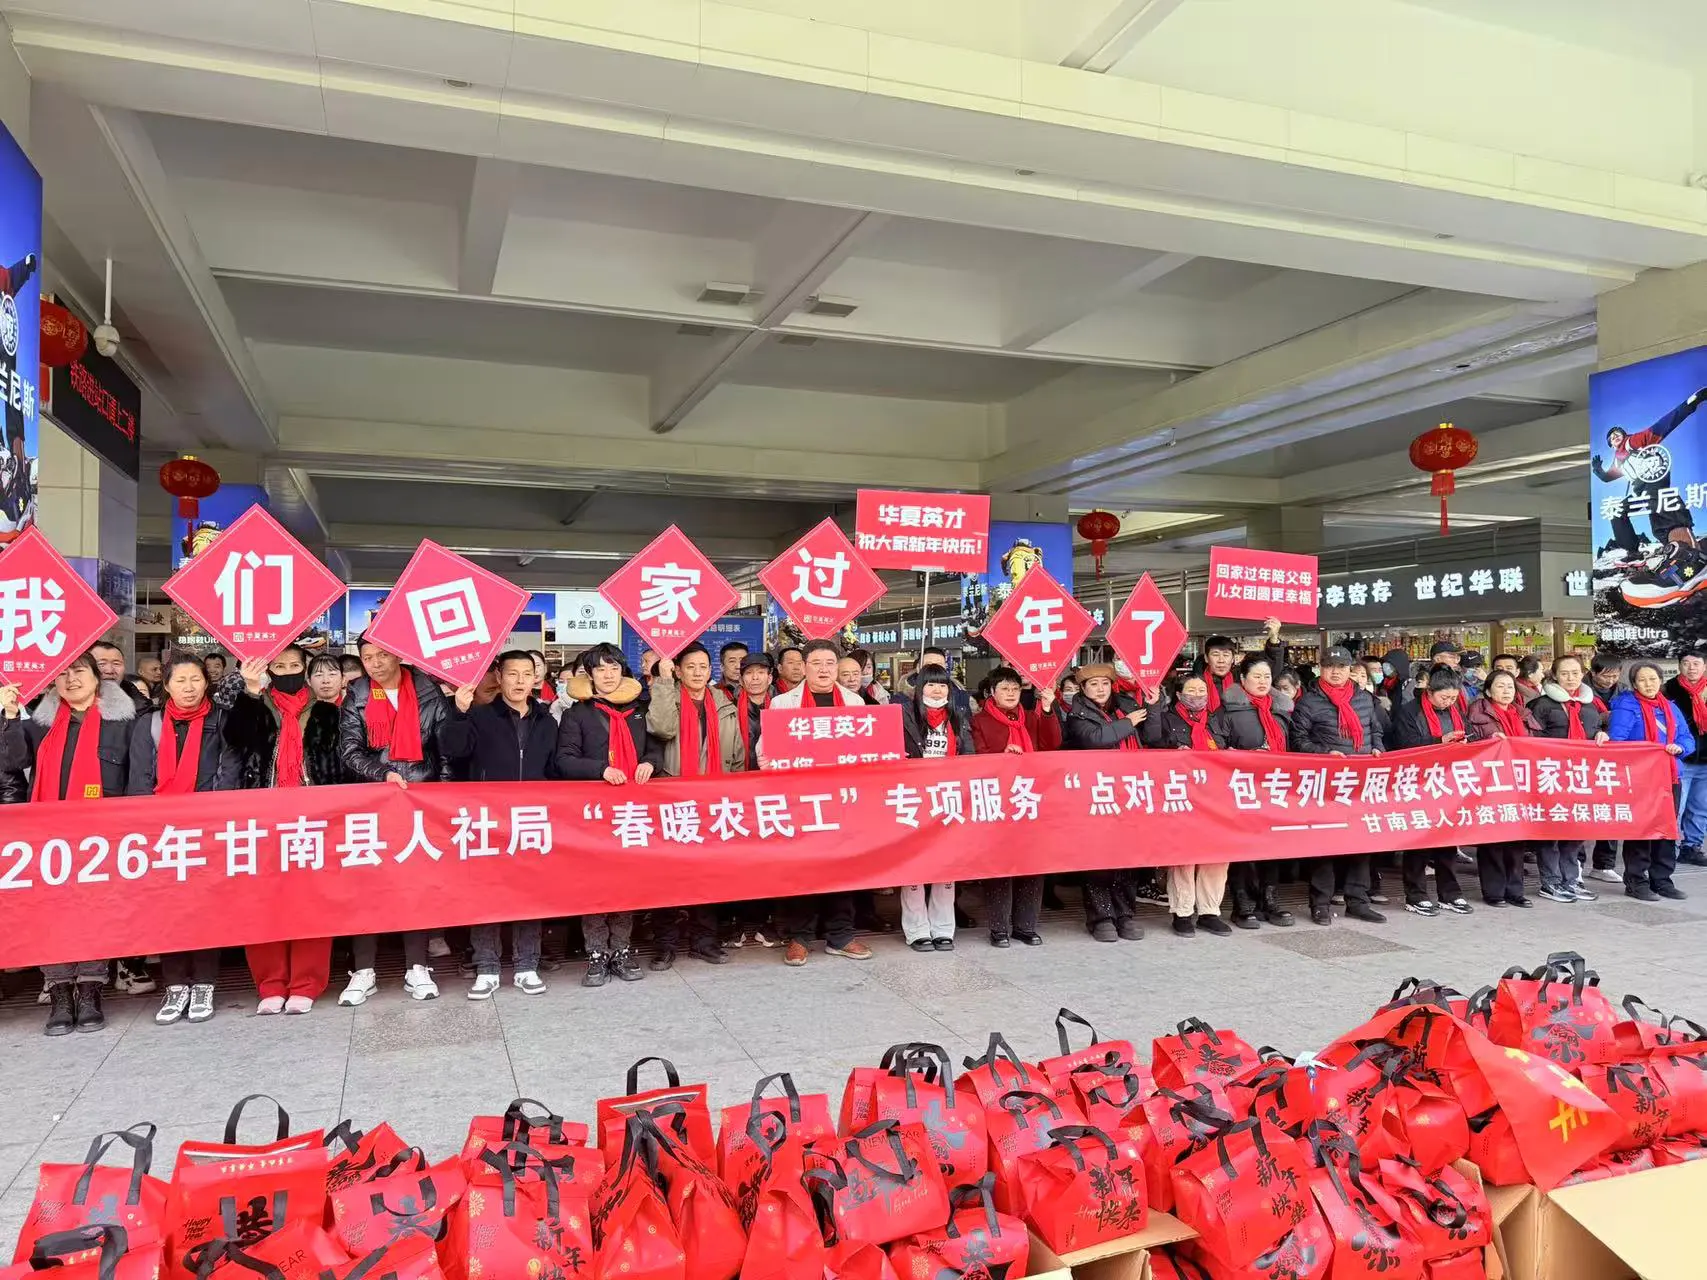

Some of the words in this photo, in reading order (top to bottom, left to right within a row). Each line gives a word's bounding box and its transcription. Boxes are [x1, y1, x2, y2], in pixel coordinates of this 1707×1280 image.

[878, 505, 966, 529] 华夏英才
[1600, 482, 1707, 521] 泰兰尼斯
[858, 534, 982, 555] 祝大家新年快乐！
[213, 550, 294, 626] 们
[637, 562, 700, 624] 家
[791, 547, 850, 609] 过
[1215, 583, 1312, 605] 儿女团圆更幸福
[1216, 563, 1312, 586] 回家过年陪父母
[1414, 566, 1526, 600] 世纪华联
[0, 577, 67, 657] 我
[405, 577, 491, 658] 回
[567, 620, 609, 630] 泰兰尼斯
[1015, 596, 1067, 653] 年
[1131, 610, 1165, 664] 了
[788, 714, 877, 740] 华夏英才
[0, 805, 553, 889] 2026年甘南县人社局
[582, 786, 859, 848] “春暖农民工”
[884, 774, 1043, 829] 专项服务
[1063, 770, 1208, 816] “点对点”
[278, 1249, 307, 1273] EAR
